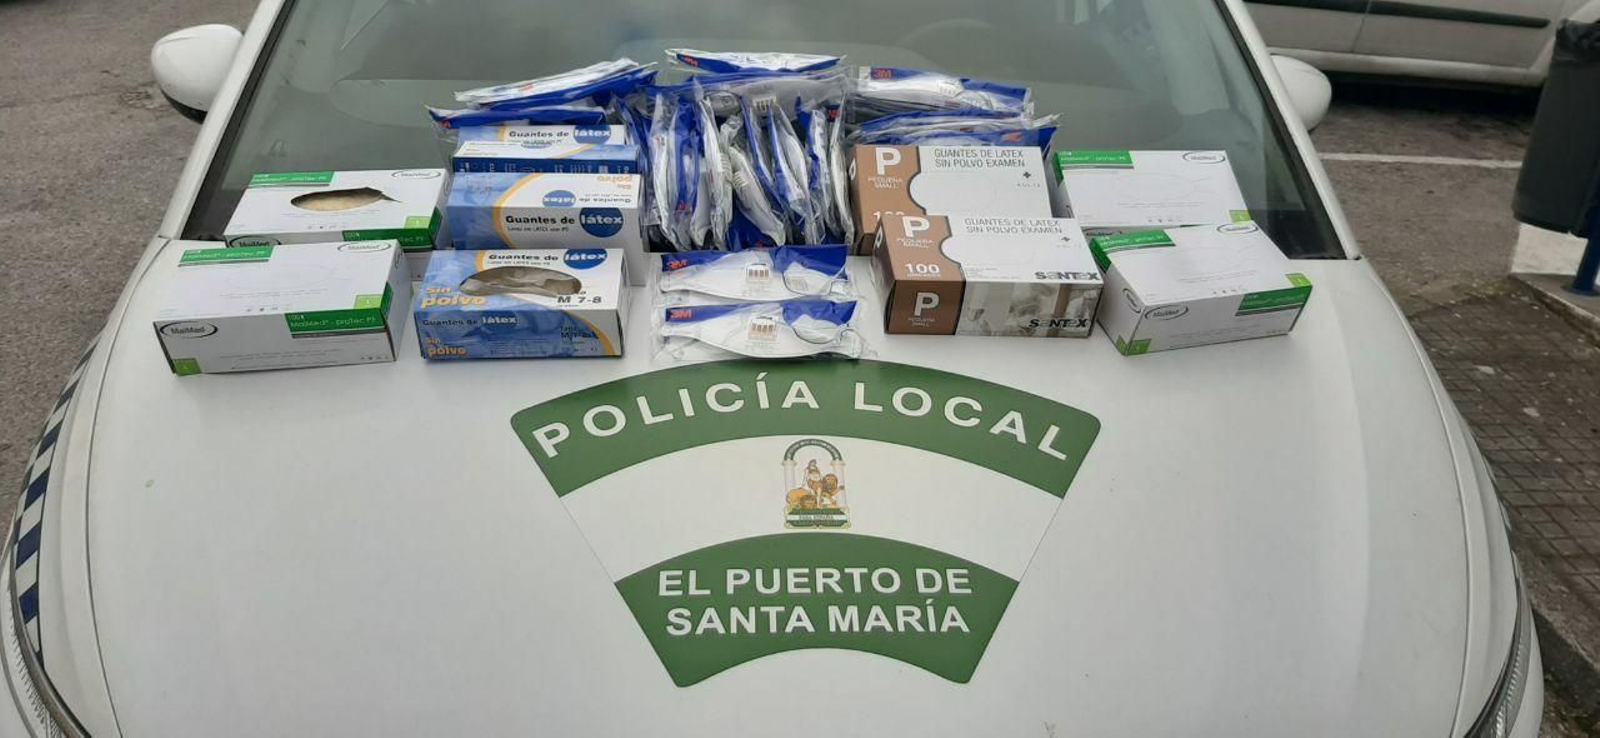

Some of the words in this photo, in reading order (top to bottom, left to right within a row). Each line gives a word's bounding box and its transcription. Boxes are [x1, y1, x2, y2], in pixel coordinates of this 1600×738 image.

[574, 129, 612, 137] látex
[934, 149, 978, 158] GUANTES
[980, 149, 992, 158] DE
[994, 149, 1024, 158] LATEX
[875, 147, 901, 175] P
[935, 159, 951, 168] SIN
[953, 159, 983, 168] POLVO
[986, 159, 1026, 168] EXAMEN
[505, 215, 557, 224] Guantes
[560, 216, 576, 224] de
[580, 213, 623, 225] látex
[964, 218, 1011, 226] GUANTES
[1029, 219, 1061, 227] LATEX
[902, 216, 930, 237] P
[986, 226, 1018, 234] POLVO
[1021, 226, 1063, 234] EXAMEN
[564, 252, 608, 261] látex
[905, 263, 940, 274] 100
[420, 294, 487, 309] polvo
[556, 295, 571, 304] M
[578, 295, 602, 304] 7-8
[914, 292, 940, 317] P
[482, 315, 518, 324] látex
[427, 346, 468, 356] polvo
[532, 372, 819, 459] POLICÍA
[854, 381, 1068, 461] LOCAL
[658, 569, 711, 596] EL
[725, 567, 902, 595] PUERTO
[916, 568, 973, 595] DE
[666, 605, 815, 636] SANTA
[827, 598, 971, 633] MARÍA
